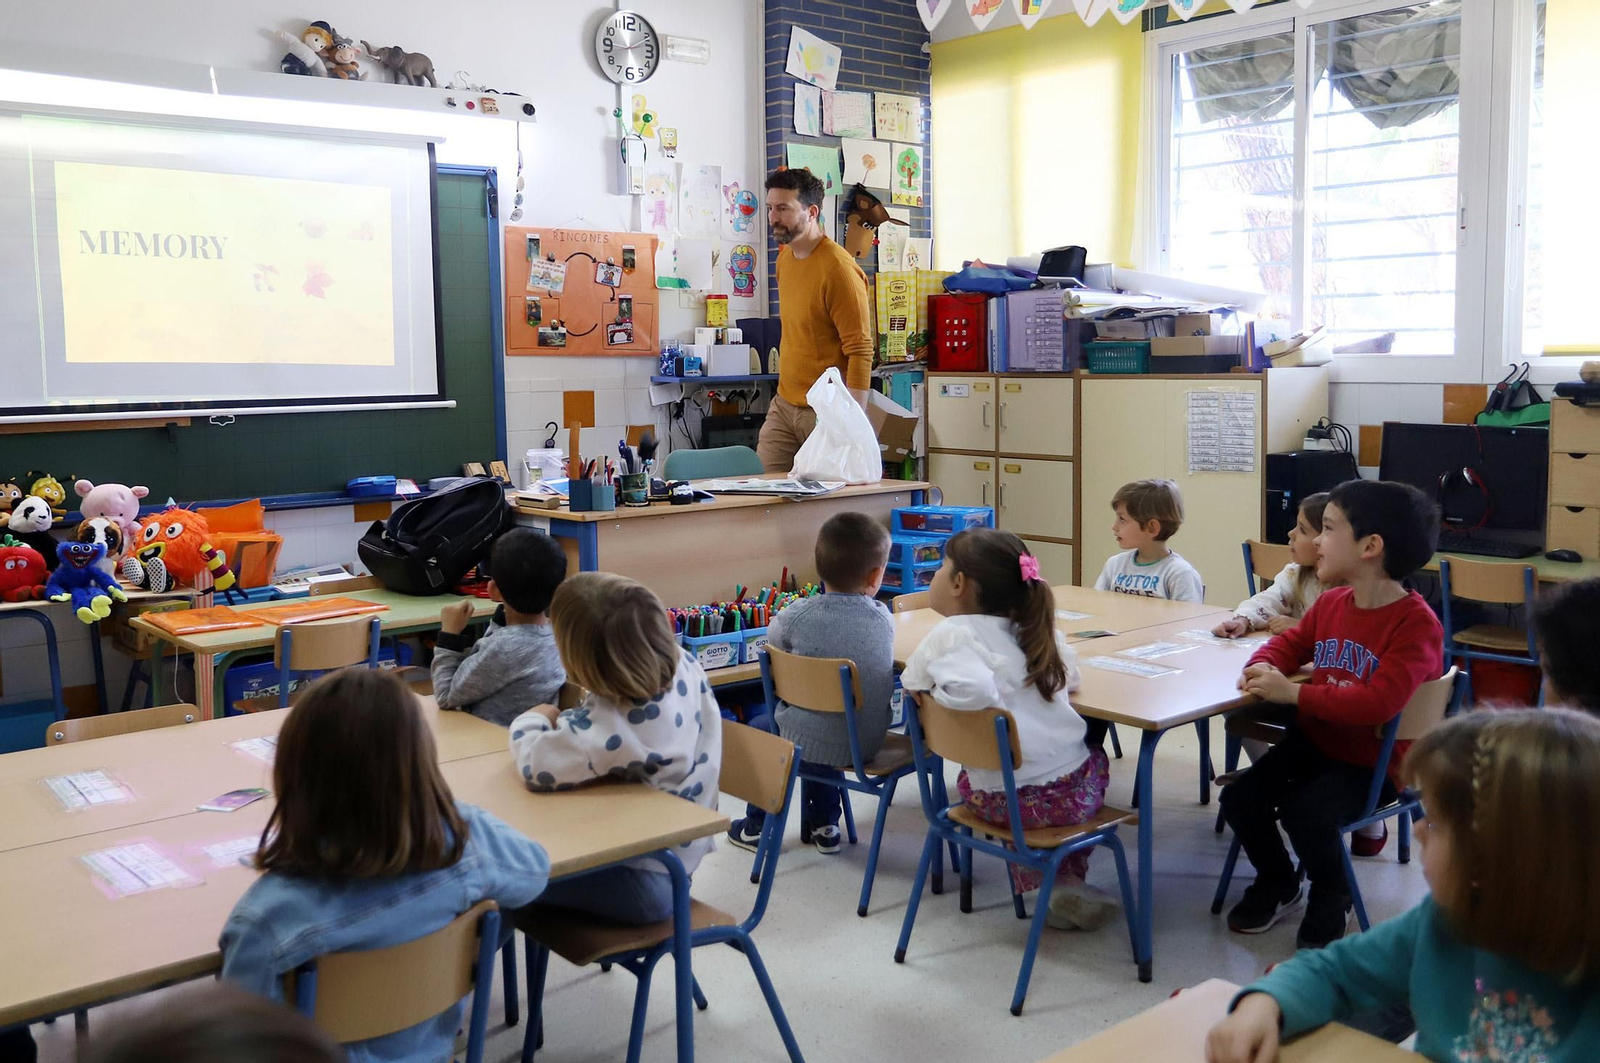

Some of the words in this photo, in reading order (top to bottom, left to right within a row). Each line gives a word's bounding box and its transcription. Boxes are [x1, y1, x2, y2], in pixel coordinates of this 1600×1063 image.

[615, 19, 621, 28] 11
[623, 15, 636, 32] 12
[606, 26, 615, 36] 10
[643, 32, 651, 42] 2
[602, 37, 613, 53] 9
[644, 43, 654, 59] 3
[607, 55, 615, 65] 8
[643, 60, 651, 70] 4
[616, 64, 623, 75] 7
[625, 66, 635, 80] 6
[638, 67, 644, 78] 5
[552, 231, 610, 244] RINCONES
[79, 229, 229, 260] MEMORY
[1114, 573, 1160, 591] MOTOR
[706, 646, 728, 655] GIOTTO
